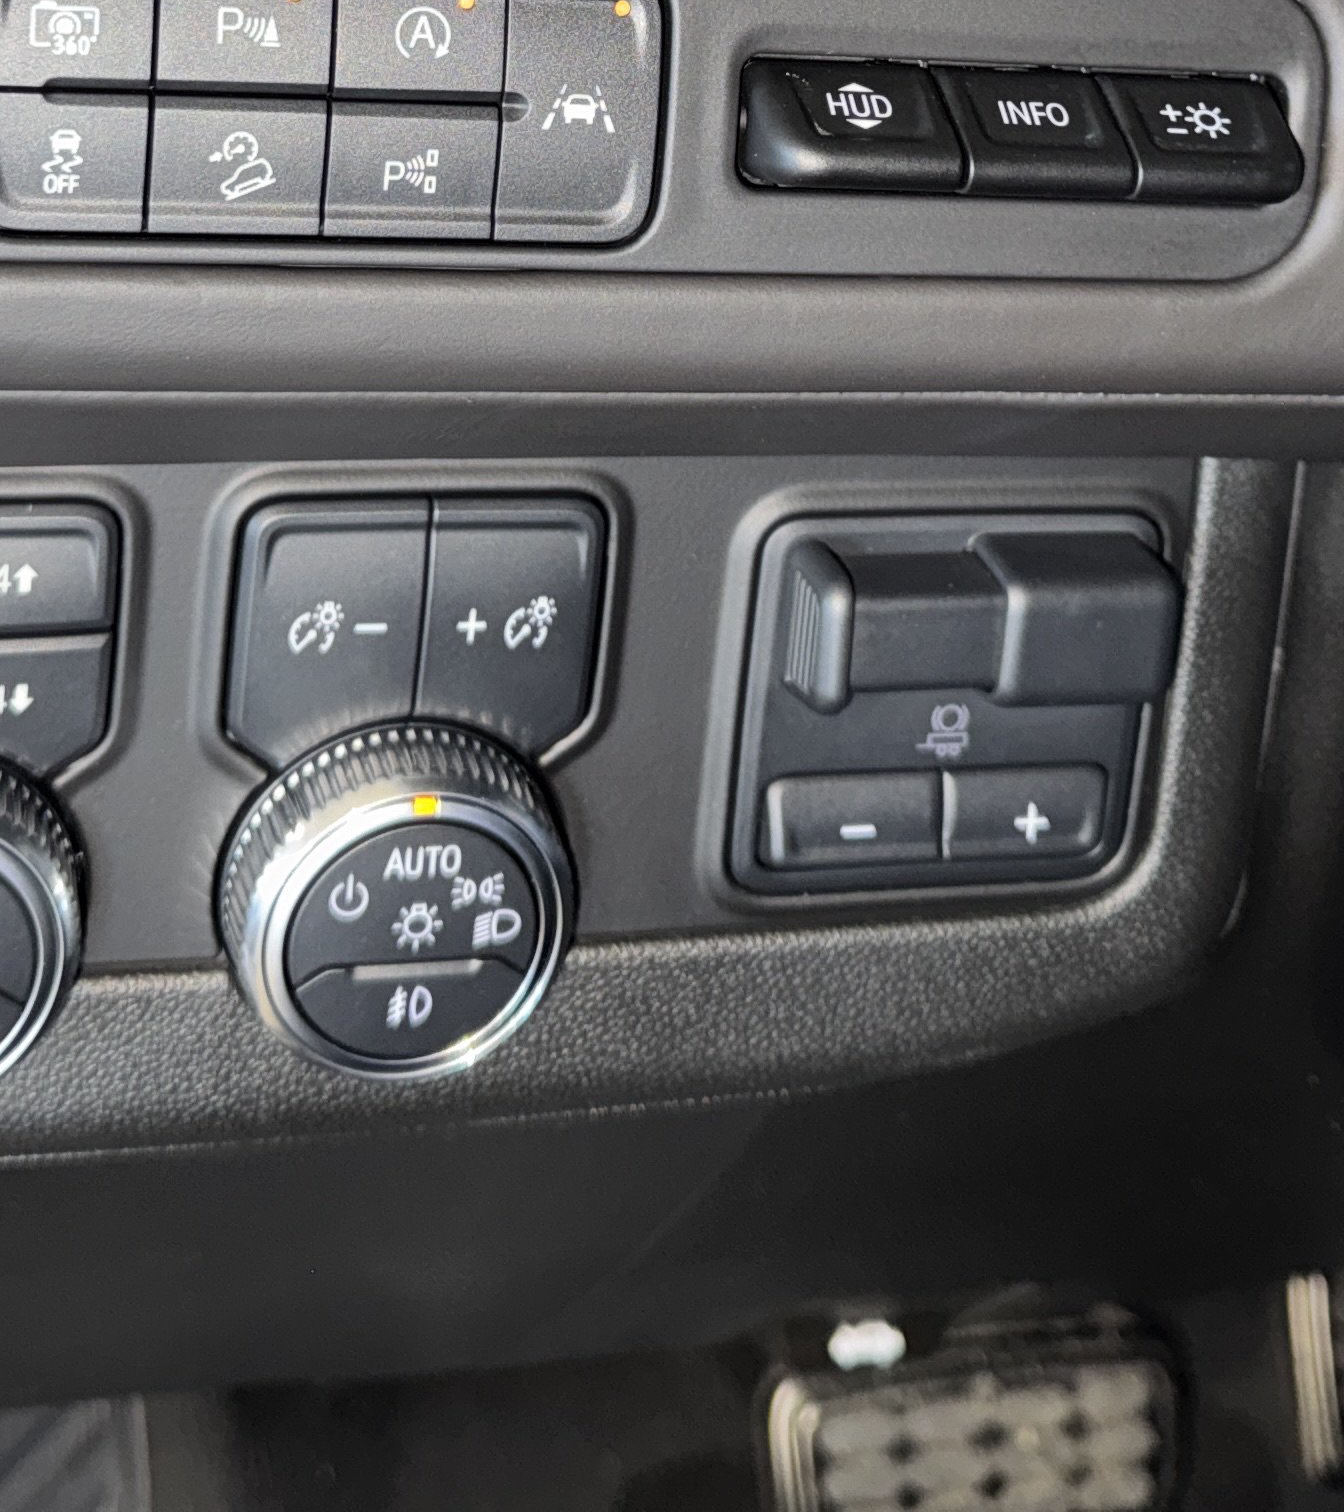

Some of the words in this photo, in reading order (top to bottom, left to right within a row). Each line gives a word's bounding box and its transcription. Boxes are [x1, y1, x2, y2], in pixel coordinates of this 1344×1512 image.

[825, 92, 893, 119] HUD
[997, 100, 1070, 127] INFO
[42, 173, 81, 194] OFF
[382, 844, 462, 881] AUTO
